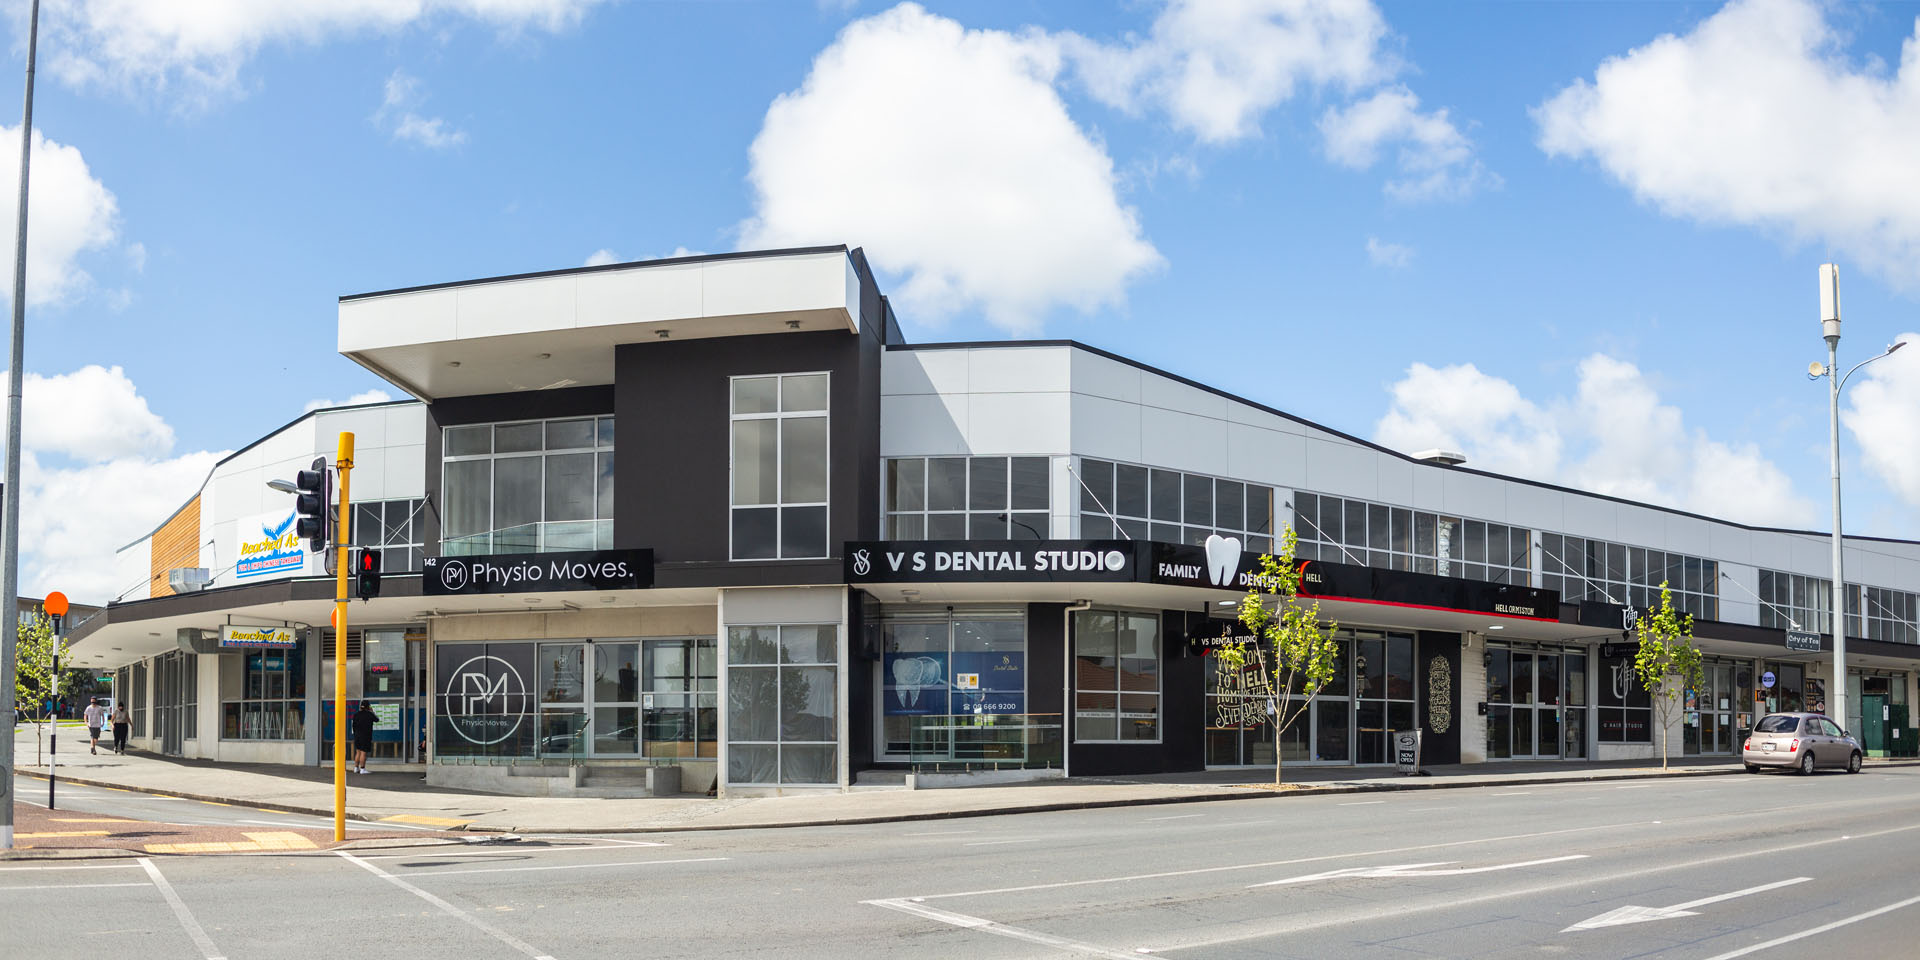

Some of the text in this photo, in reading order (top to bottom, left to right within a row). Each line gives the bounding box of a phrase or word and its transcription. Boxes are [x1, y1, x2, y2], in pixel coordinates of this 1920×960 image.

[241, 533, 300, 555] Beached As
[424, 558, 436, 566] 142
[886, 551, 1126, 572] V S DENTAL STUDIO
[472, 560, 634, 586] Physio Moves.
[1159, 562, 1201, 579] FAMILY
[1305, 573, 1322, 583] HELL
[1495, 603, 1535, 615] HELL ORMISTON
[230, 630, 291, 641] Beached As
[1211, 637, 1234, 645] DENTAL
[1234, 635, 1257, 643] STUDIO
[1788, 635, 1801, 643] City
[1215, 670, 1231, 688] TO
[1216, 685, 1240, 704] HOM
